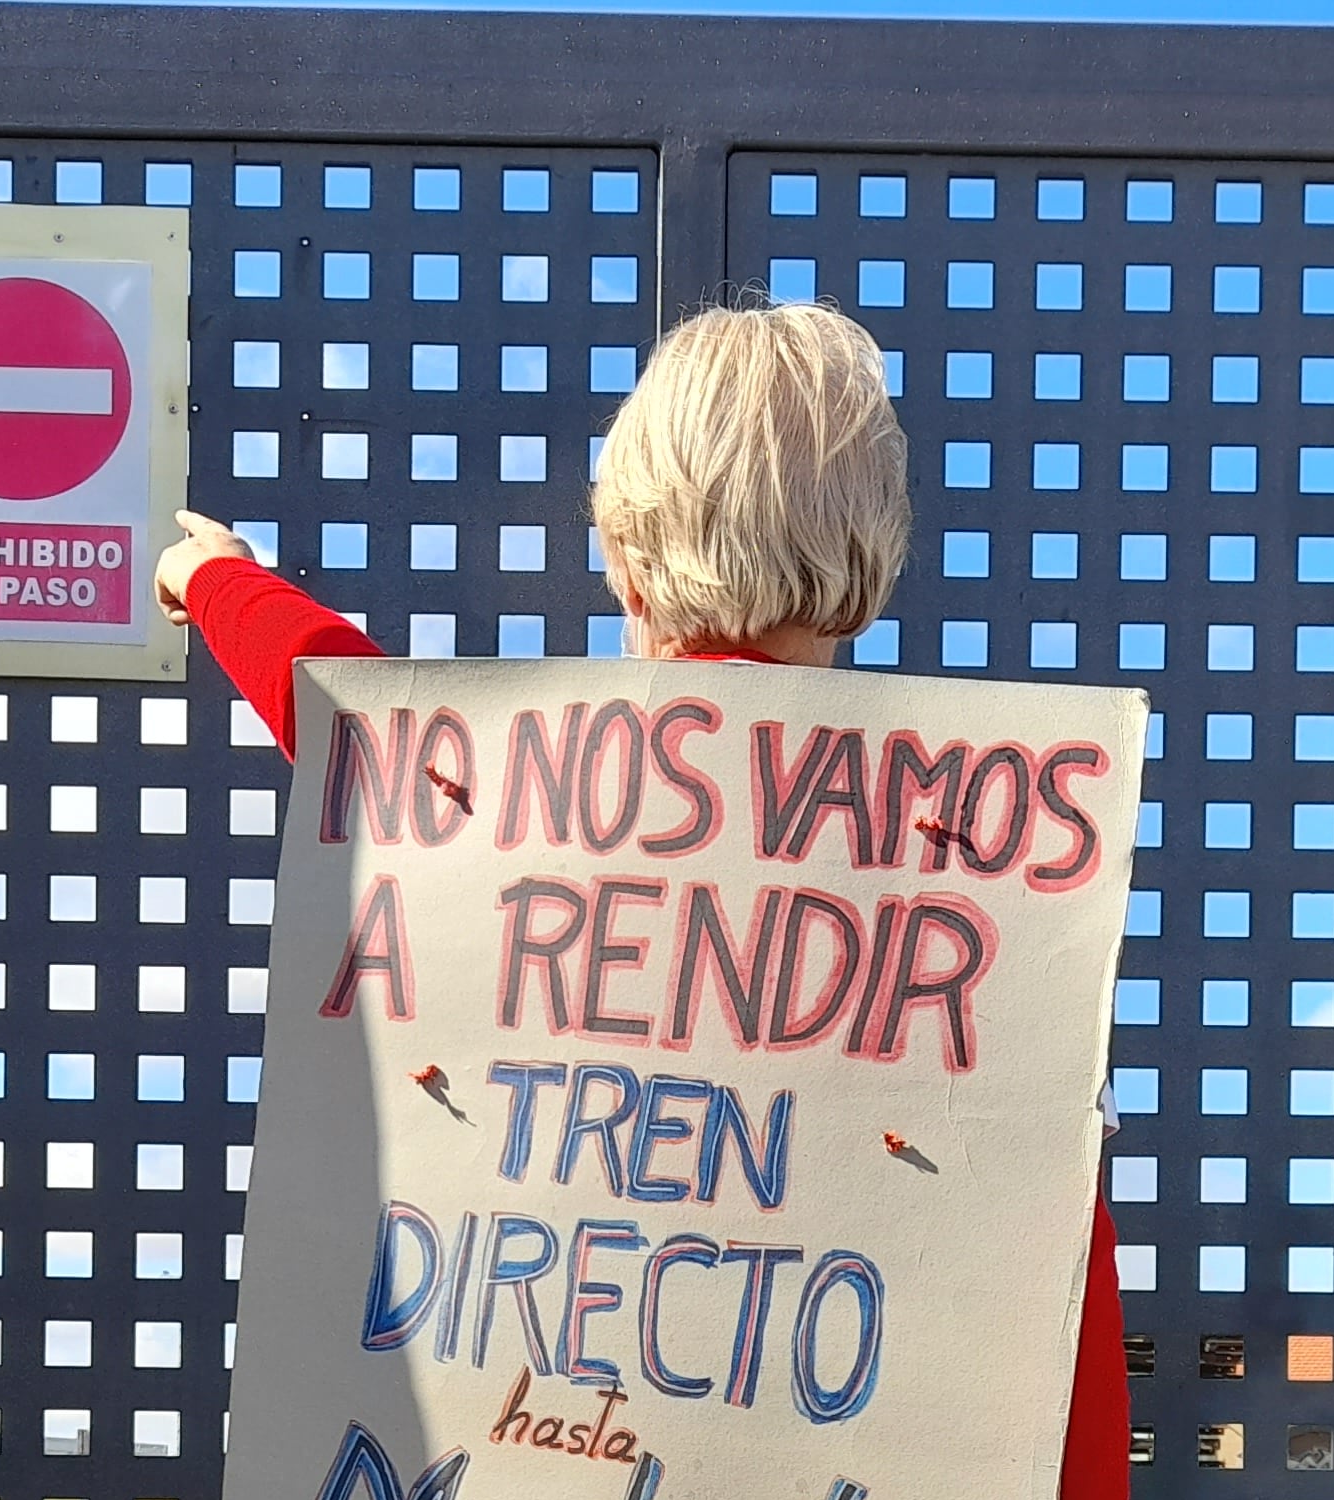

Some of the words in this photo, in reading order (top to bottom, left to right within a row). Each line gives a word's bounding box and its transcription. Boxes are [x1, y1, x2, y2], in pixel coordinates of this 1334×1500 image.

[320, 705, 475, 849] NO
[494, 695, 724, 858] NOS
[750, 720, 1111, 893] VAMOS
[318, 873, 416, 1021] A
[488, 874, 1003, 1076] RENDIR
[487, 1060, 796, 1213] TREN
[361, 1200, 886, 1426] DIRECTO
[488, 1366, 639, 1464] hasta
